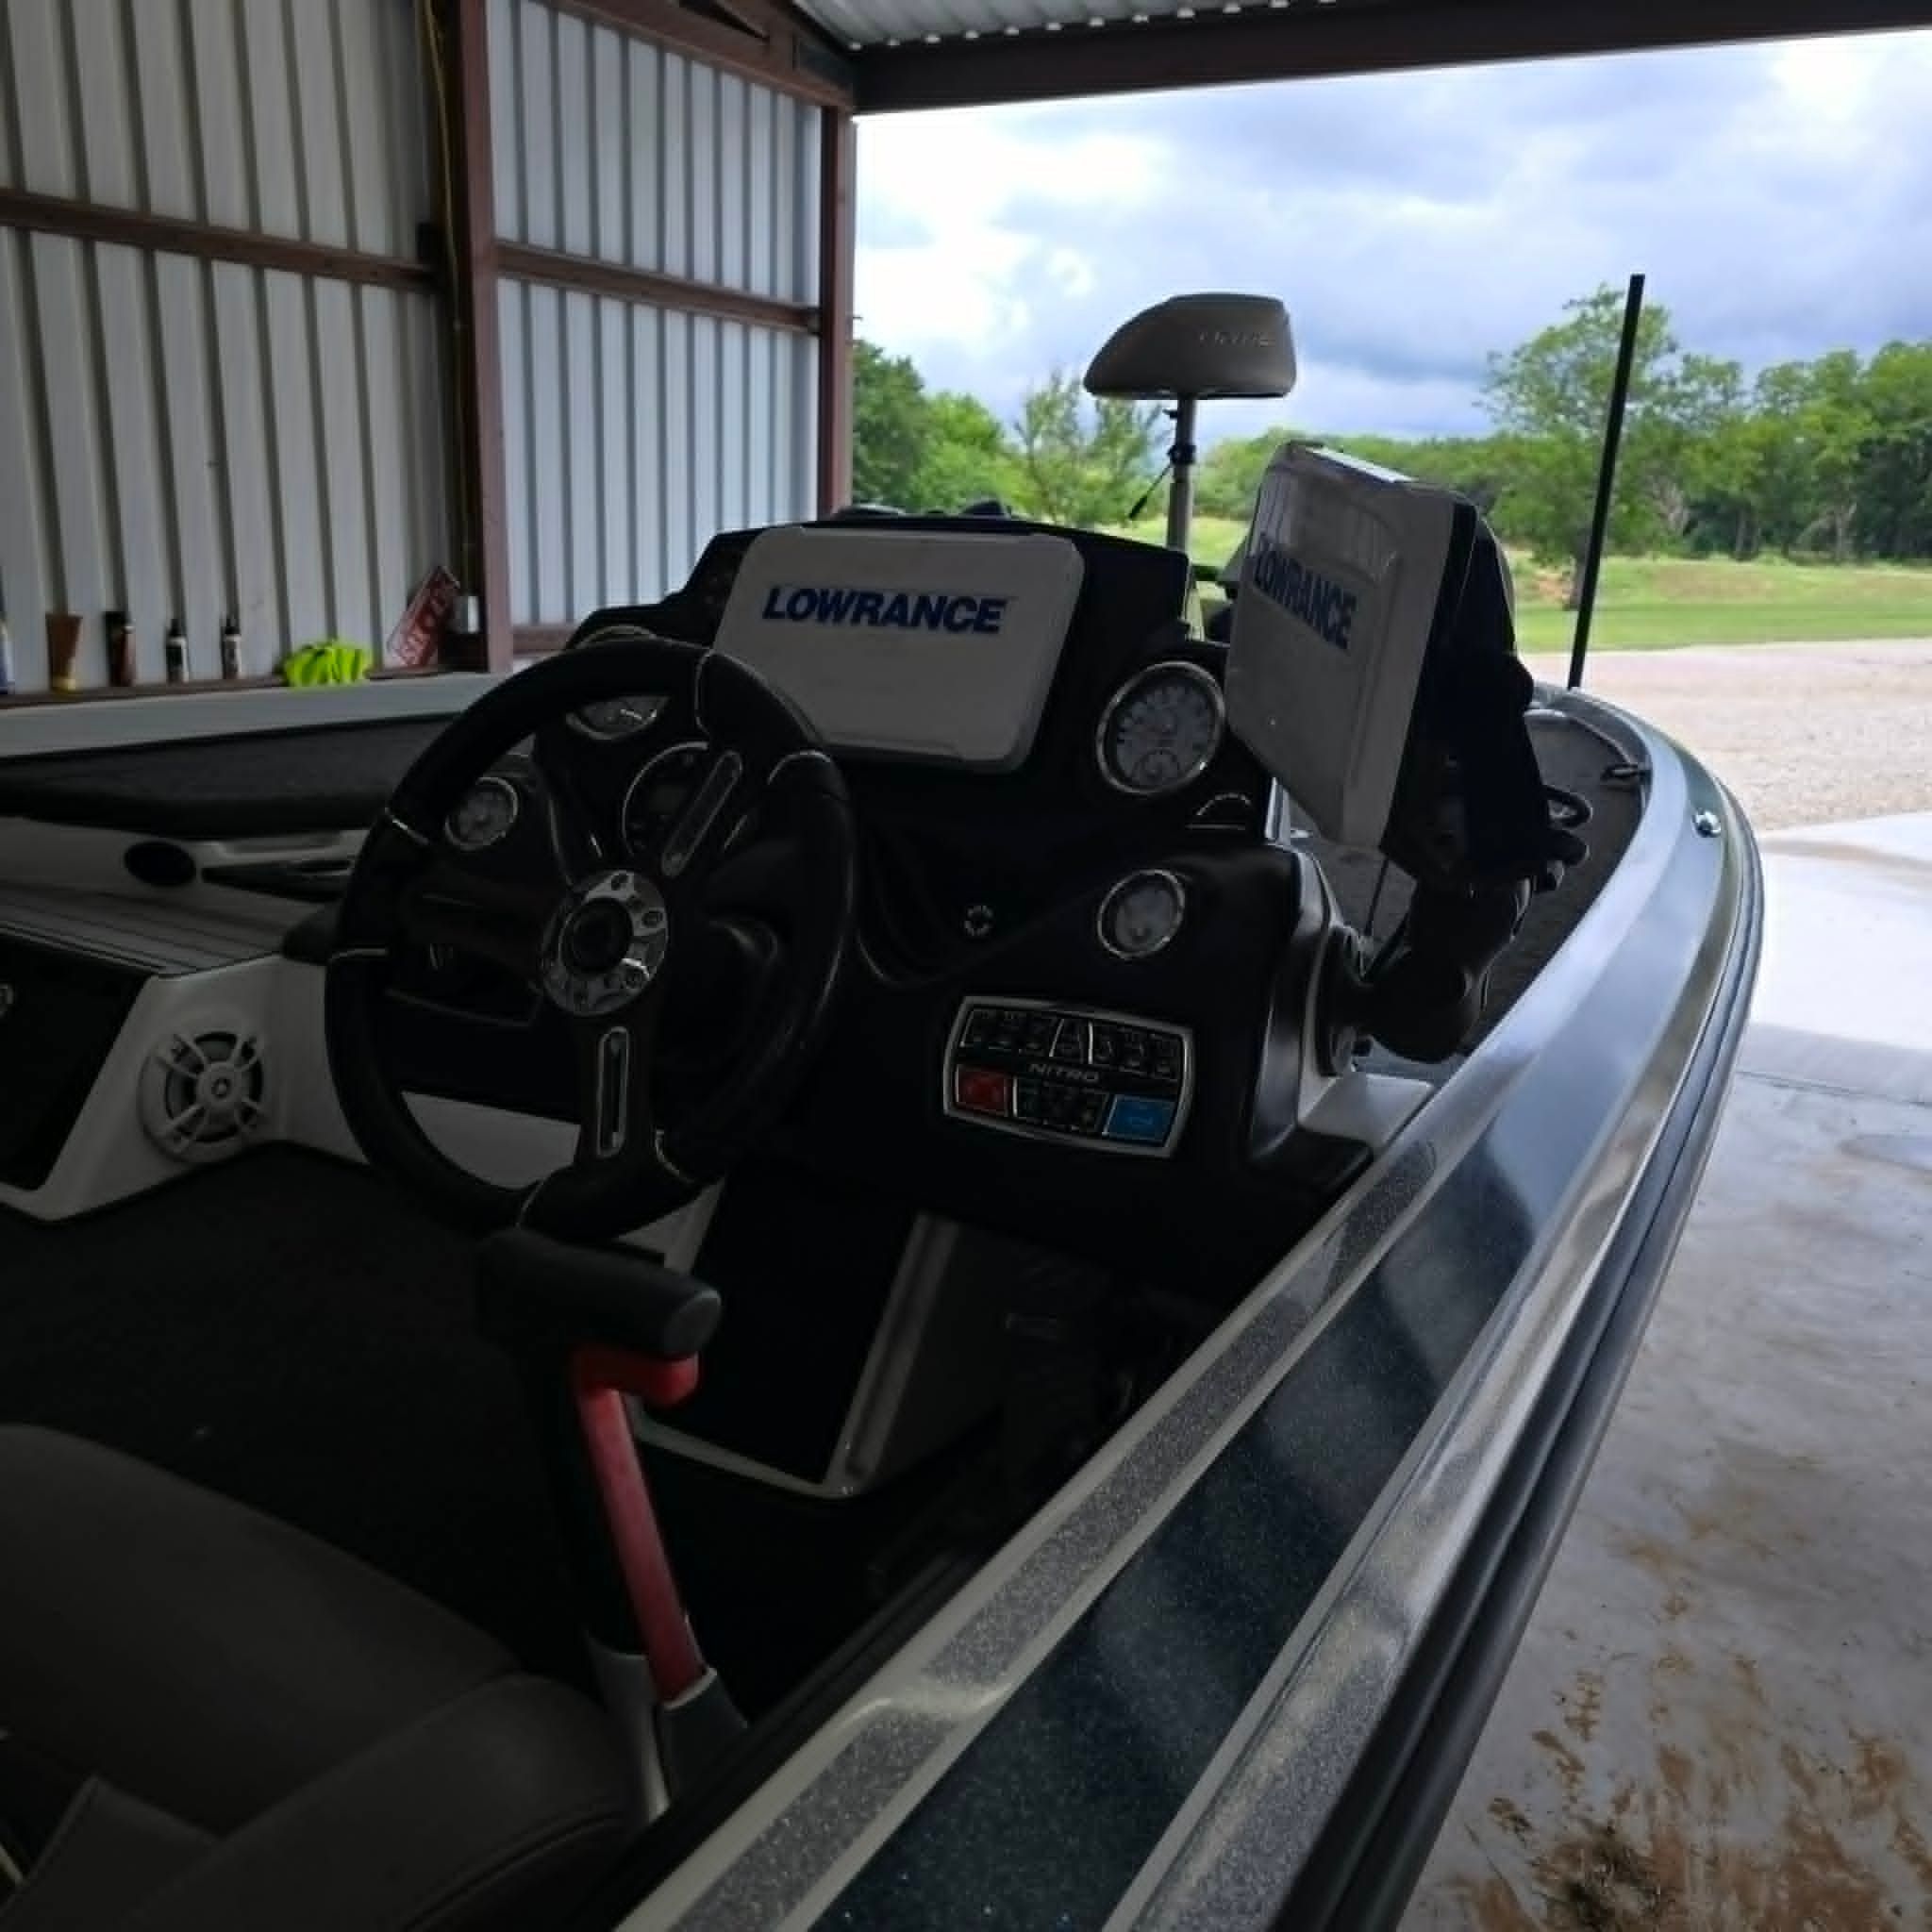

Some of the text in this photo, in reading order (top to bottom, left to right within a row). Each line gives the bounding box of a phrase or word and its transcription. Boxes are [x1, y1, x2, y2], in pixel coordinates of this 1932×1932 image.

[762, 586, 1008, 634] LOWRANCE
[1253, 541, 1357, 649] LOWRANCE
[1027, 1063, 1101, 1083] NITRO
